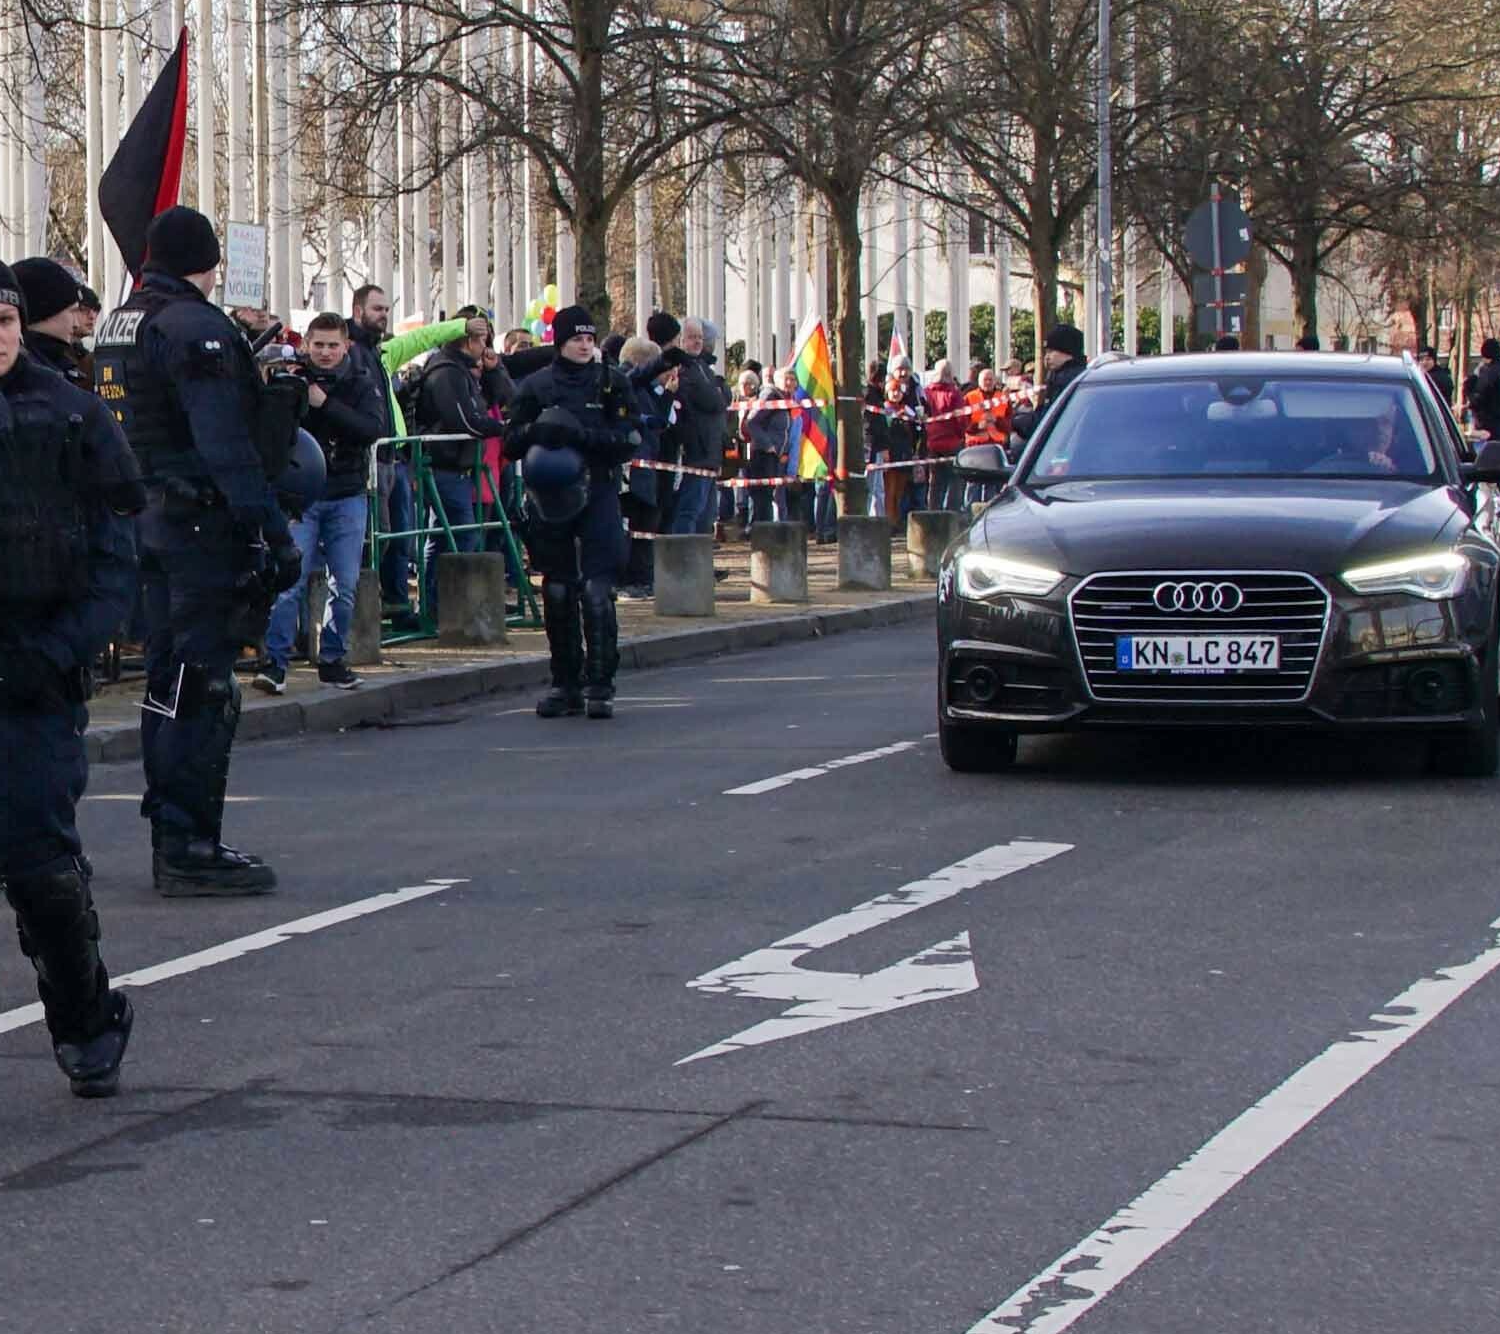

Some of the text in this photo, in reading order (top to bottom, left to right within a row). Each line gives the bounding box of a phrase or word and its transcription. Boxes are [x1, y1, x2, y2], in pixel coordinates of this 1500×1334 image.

[97, 311, 145, 343] OLIZEI
[1135, 640, 1169, 665] KN
[1187, 641, 1220, 665] LC
[1226, 641, 1275, 665] 847
